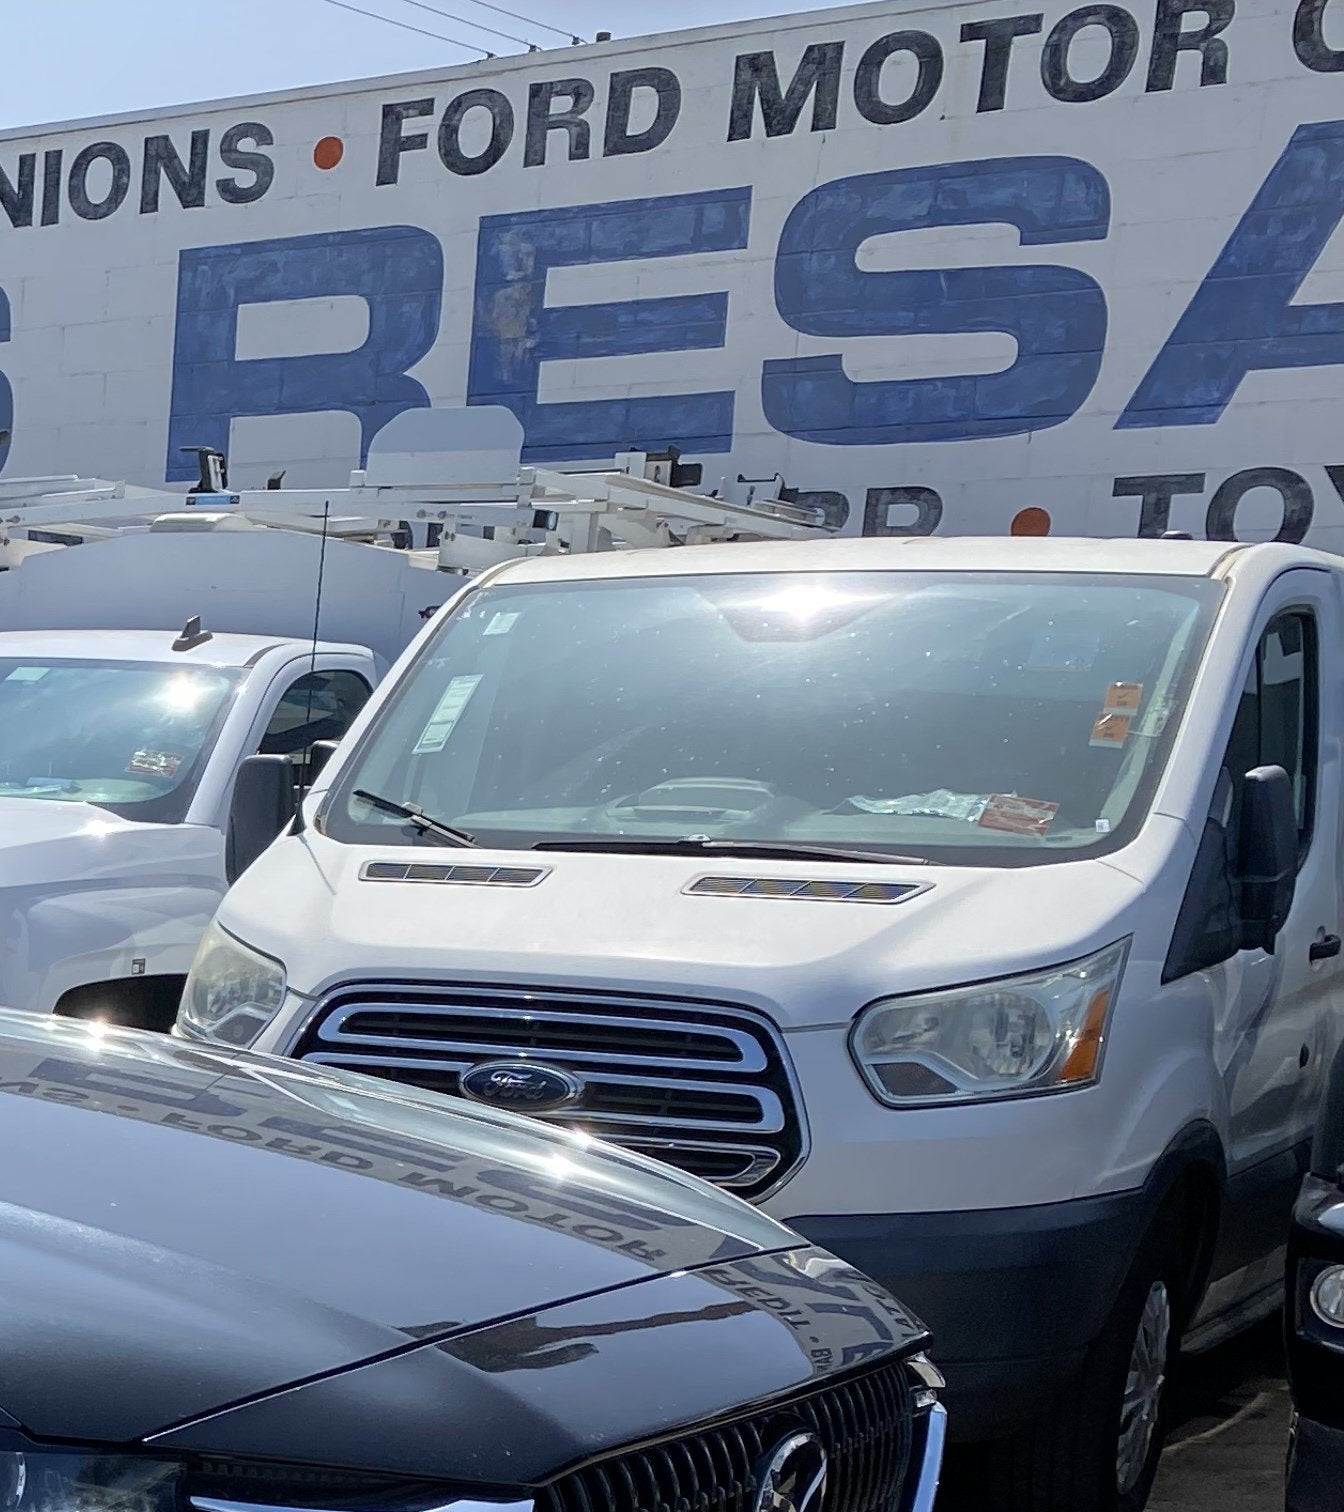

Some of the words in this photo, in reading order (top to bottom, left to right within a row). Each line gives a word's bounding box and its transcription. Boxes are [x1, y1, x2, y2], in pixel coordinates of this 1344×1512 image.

[375, 66, 682, 187] FORD
[726, 0, 1238, 143] MOTOR
[1112, 465, 1344, 544] TO
[485, 1070, 548, 1100] Ford
